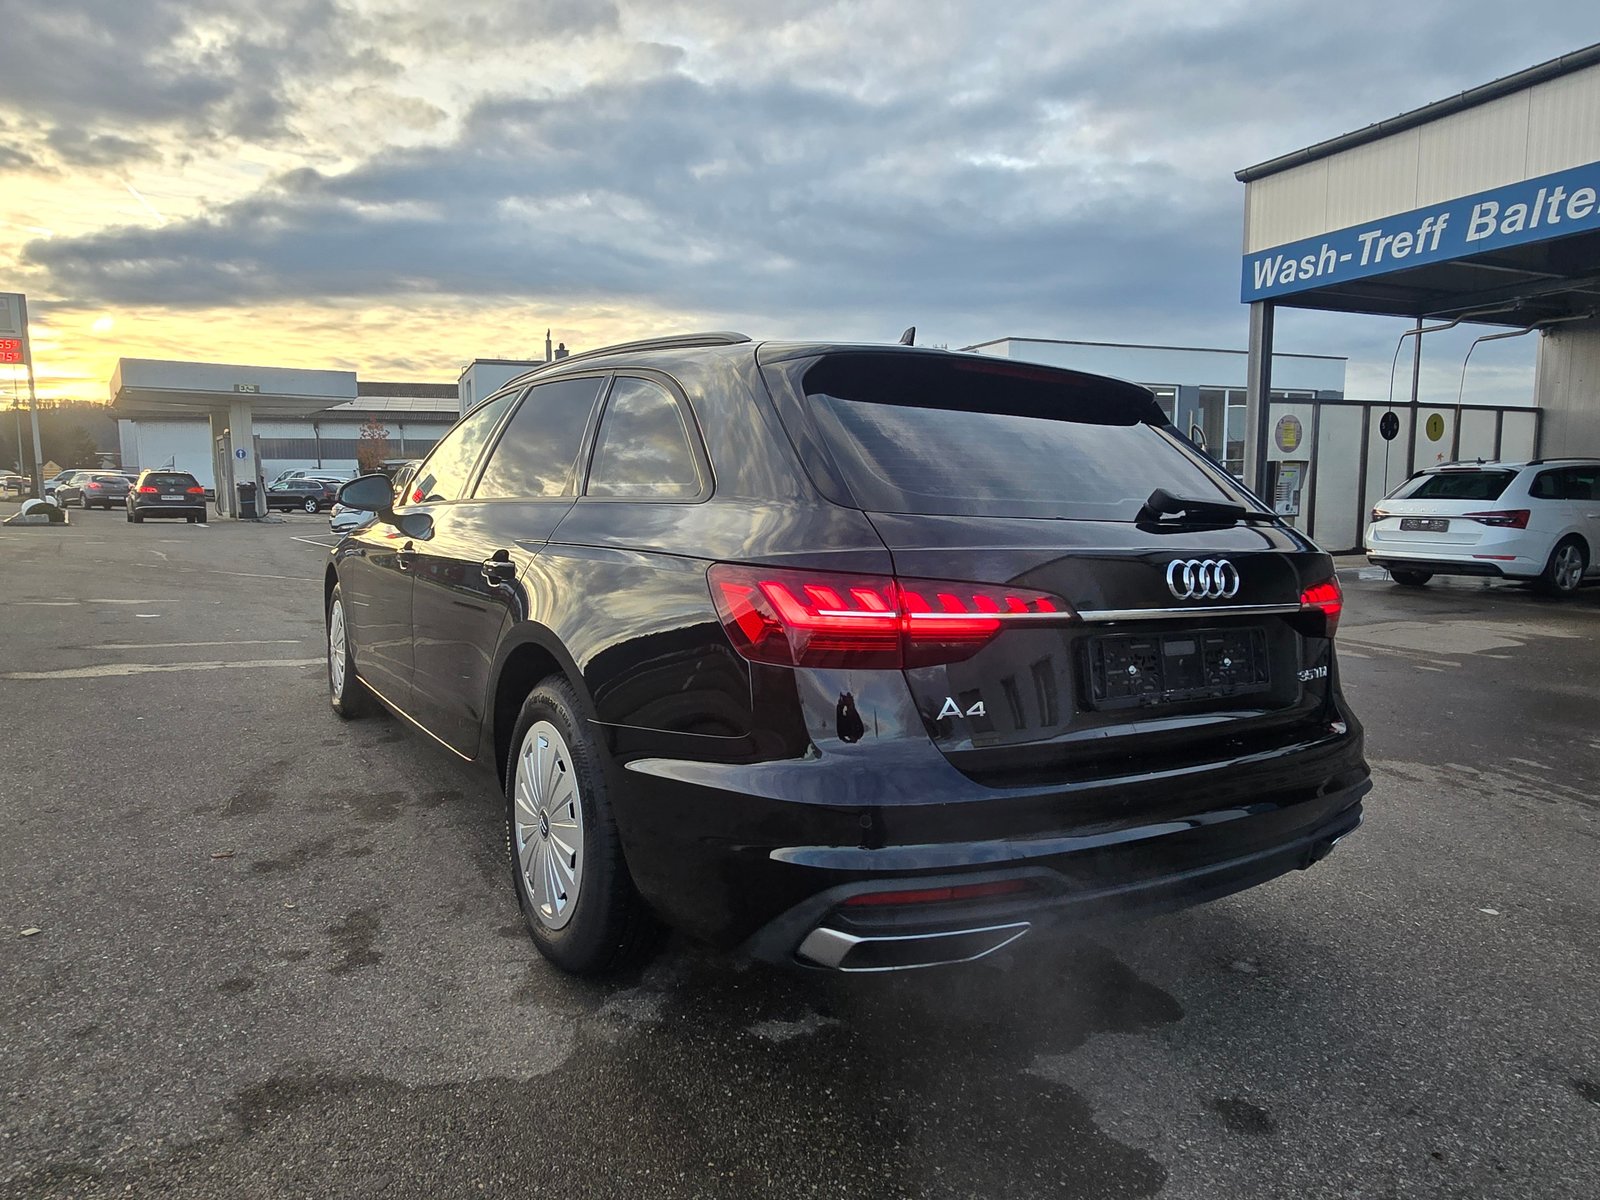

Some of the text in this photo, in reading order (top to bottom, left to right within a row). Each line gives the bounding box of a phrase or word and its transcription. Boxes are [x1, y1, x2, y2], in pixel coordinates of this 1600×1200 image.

[1252, 185, 1600, 290] Wash-Treff Balte
[936, 696, 986, 720] A4
